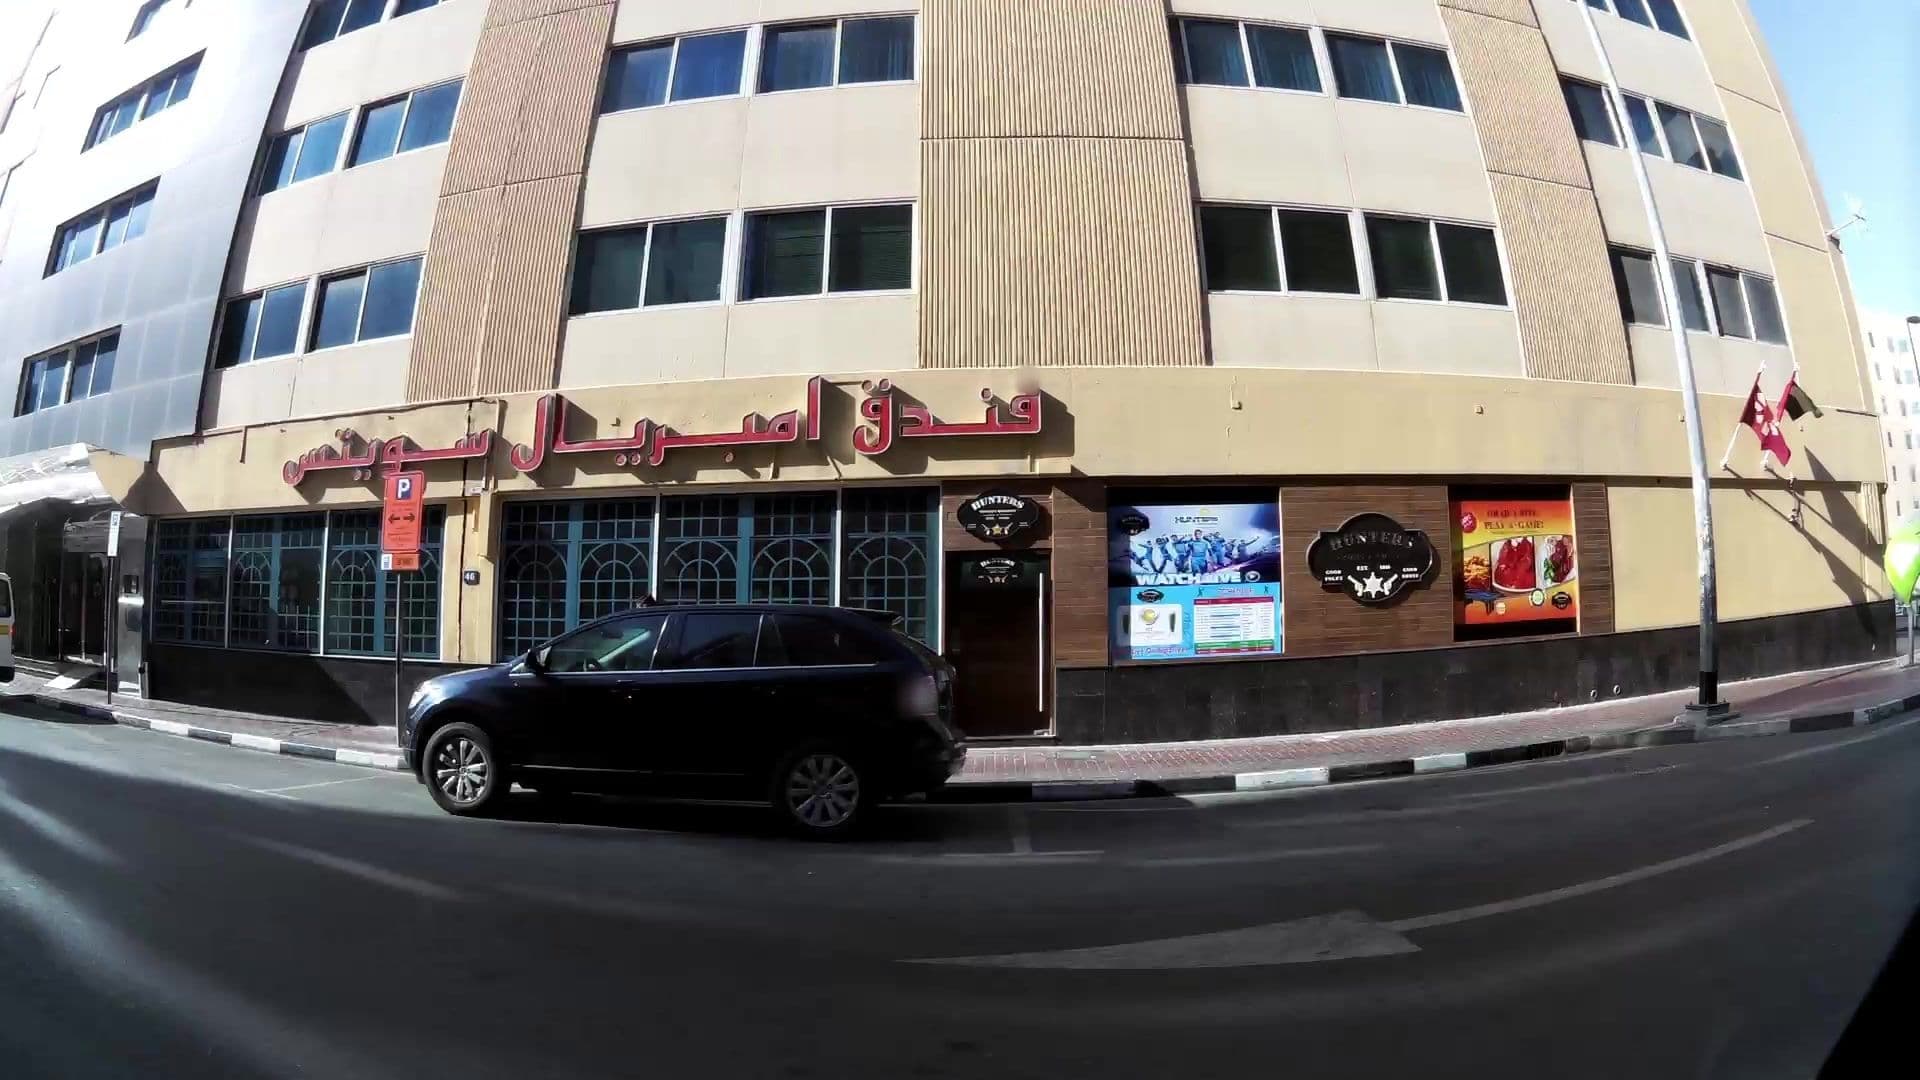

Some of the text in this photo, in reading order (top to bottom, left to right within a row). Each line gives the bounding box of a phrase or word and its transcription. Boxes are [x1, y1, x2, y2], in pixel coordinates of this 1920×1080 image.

[511, 375, 821, 472] امبريال
[853, 378, 1041, 455] فندق
[397, 479, 411, 499] P
[971, 496, 1025, 511] HUNTERS
[1135, 573, 1201, 586] WATCH
